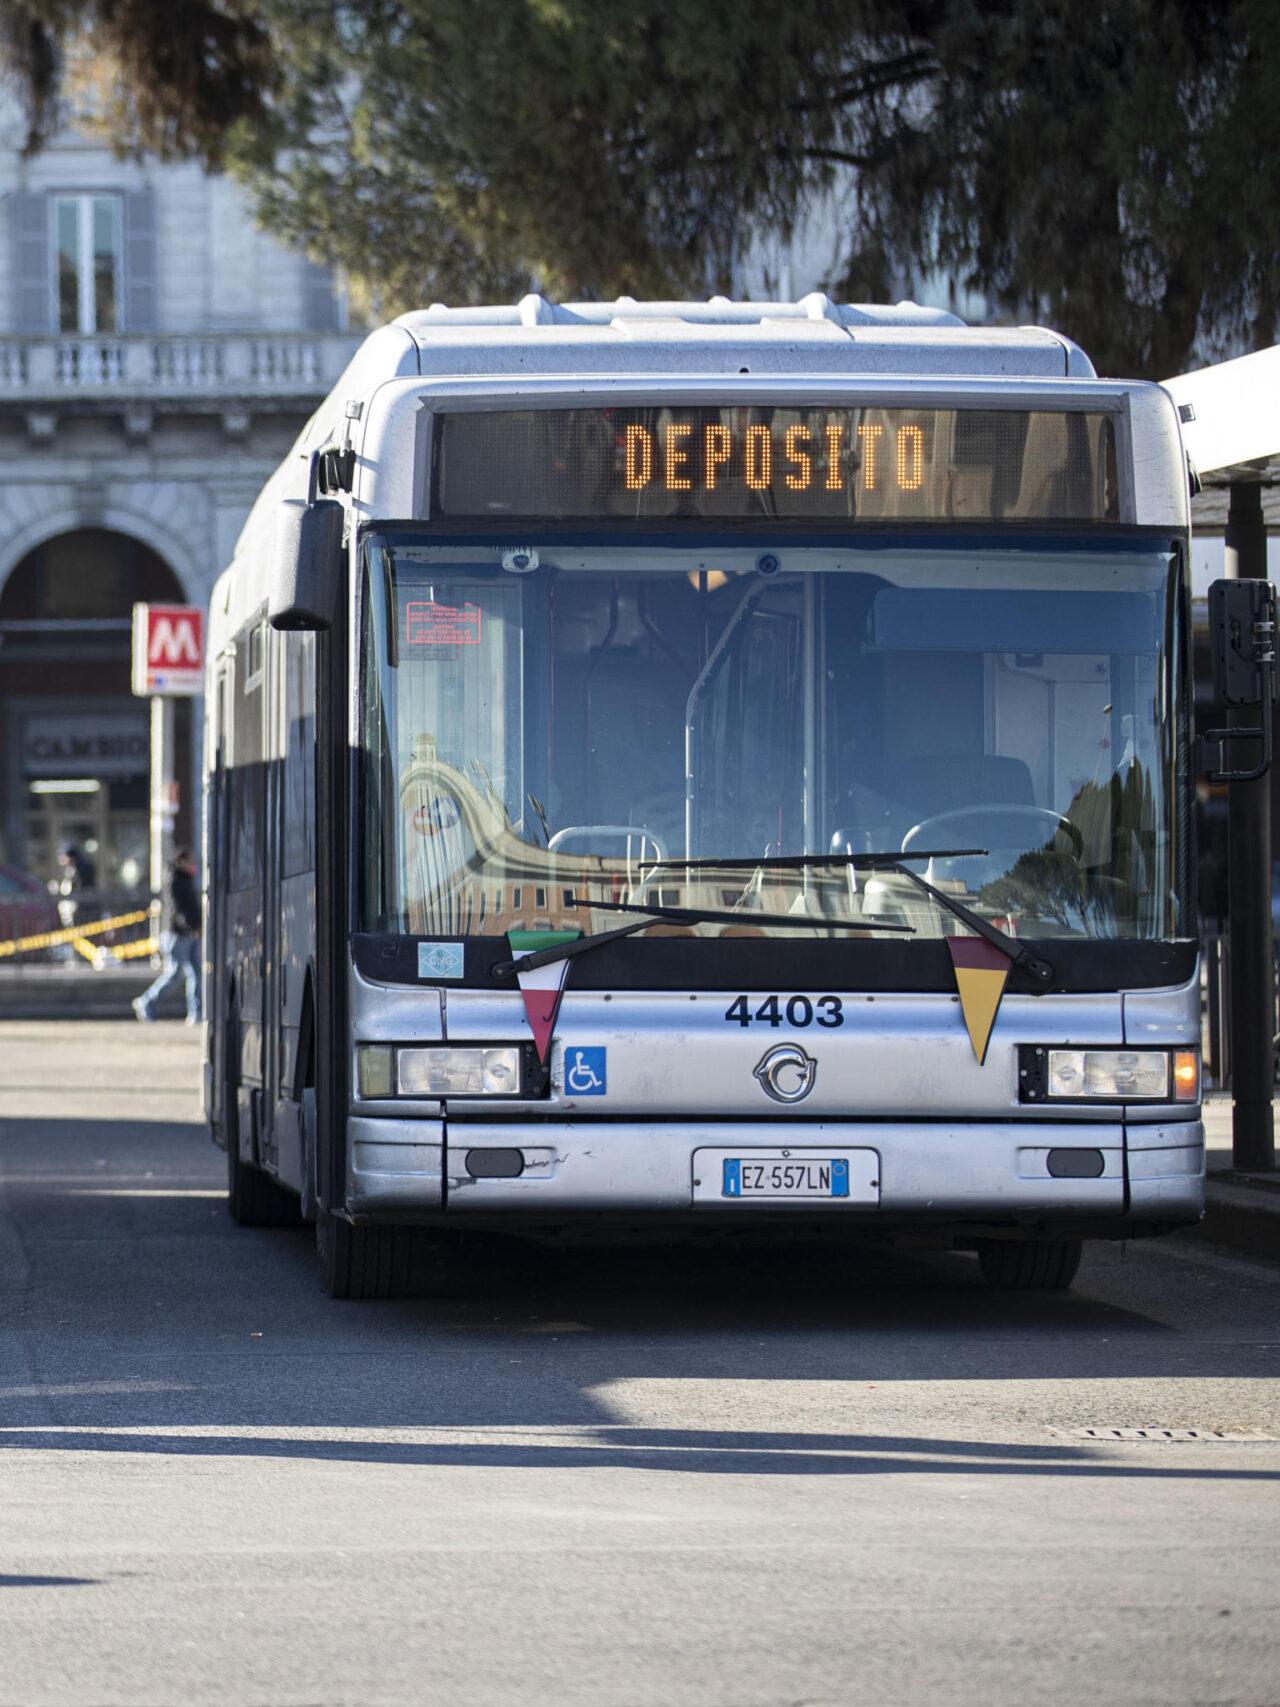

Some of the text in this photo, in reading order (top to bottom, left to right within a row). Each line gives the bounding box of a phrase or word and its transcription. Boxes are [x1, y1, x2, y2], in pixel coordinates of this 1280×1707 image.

[625, 424, 923, 490] DEPOSITO
[149, 617, 198, 662] M
[724, 994, 845, 1028] 4403
[741, 1166, 830, 1189] EZ 557LN
